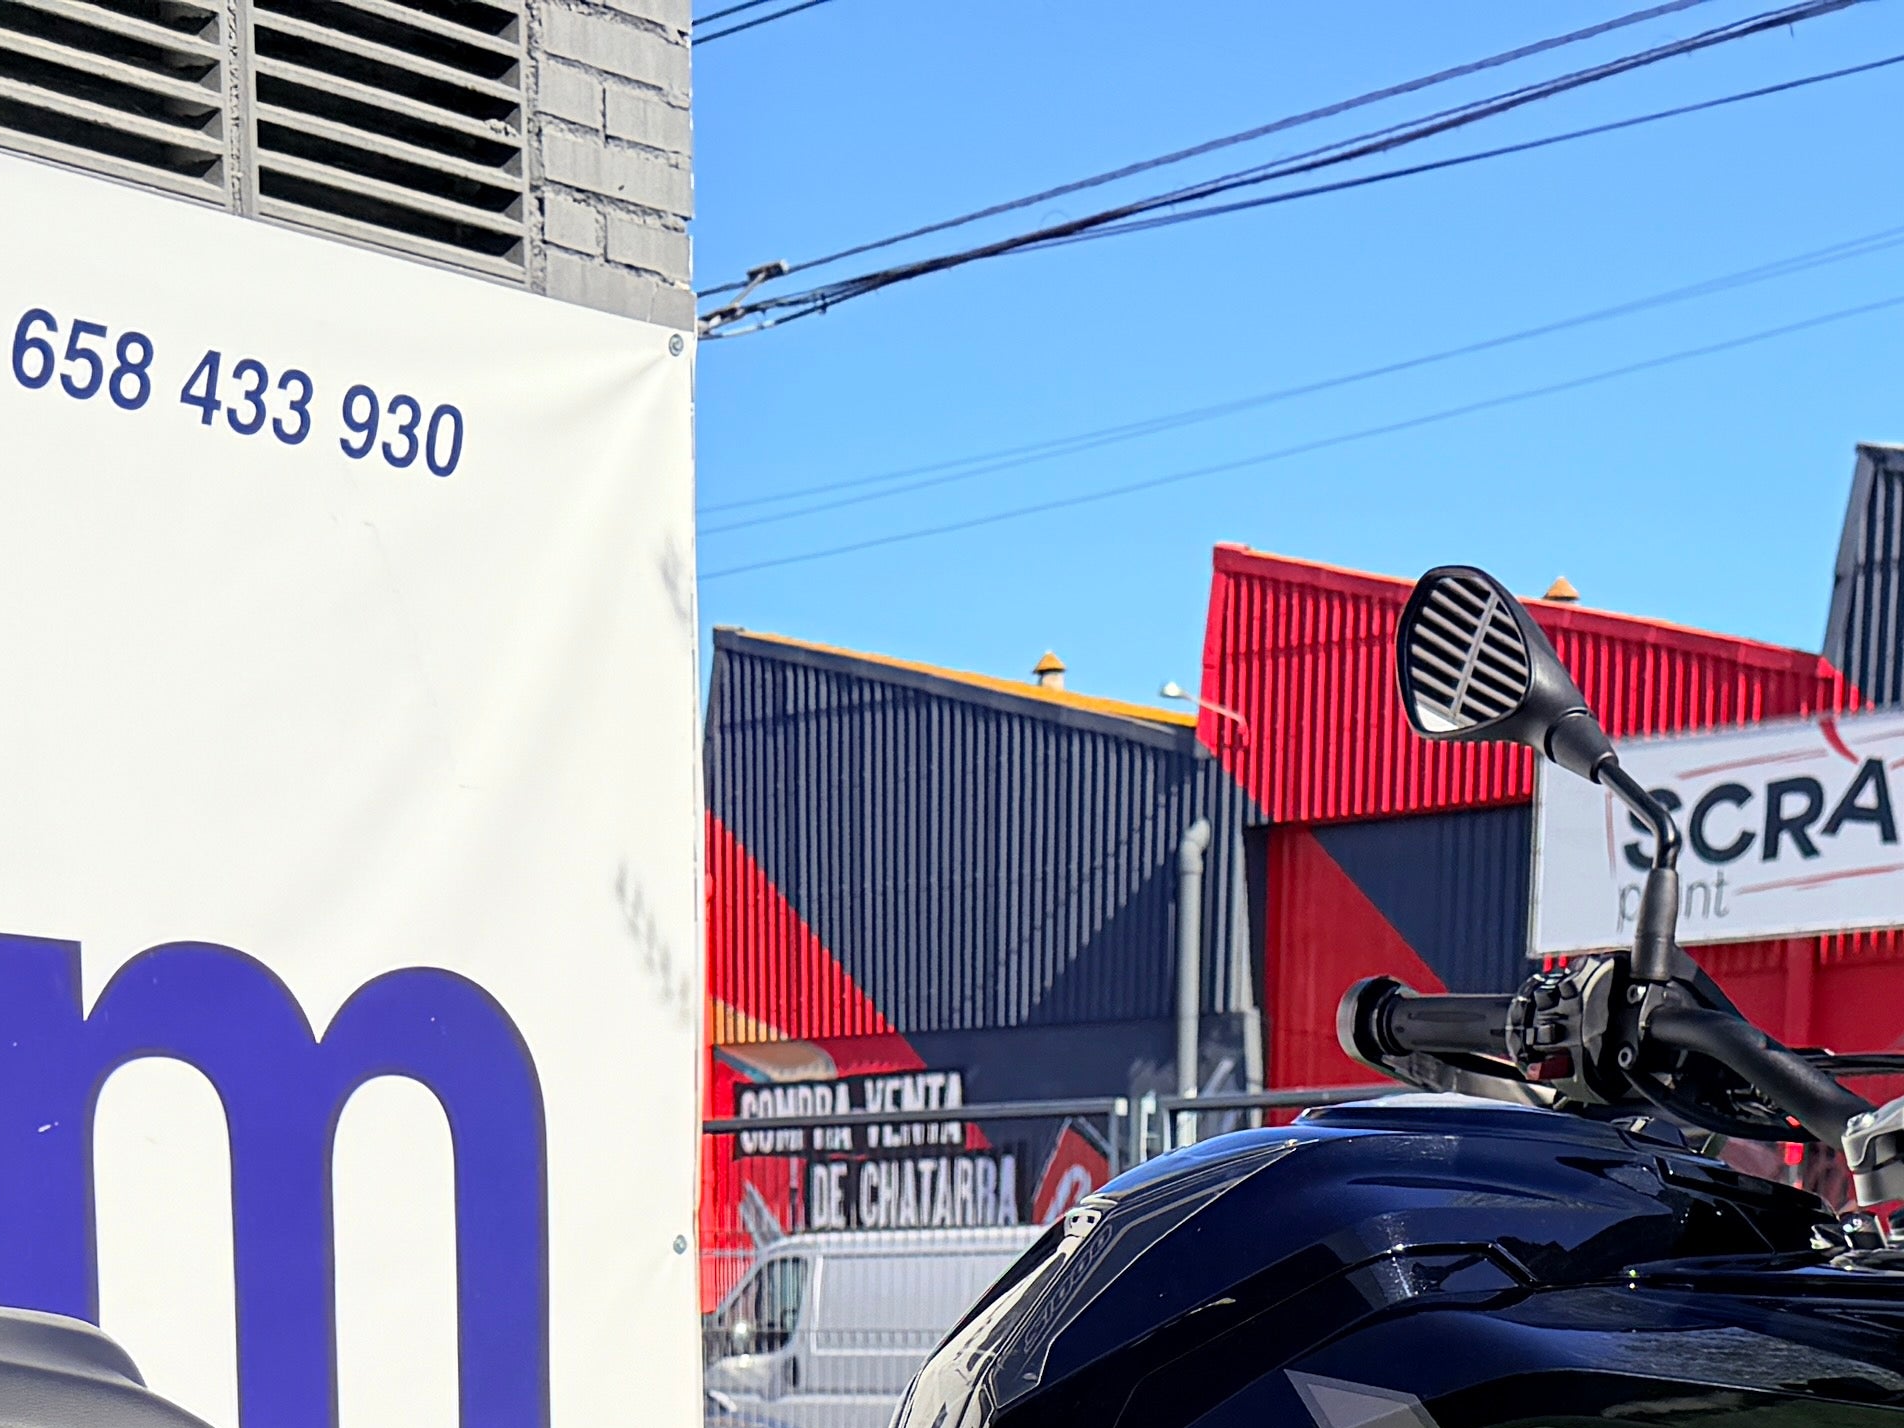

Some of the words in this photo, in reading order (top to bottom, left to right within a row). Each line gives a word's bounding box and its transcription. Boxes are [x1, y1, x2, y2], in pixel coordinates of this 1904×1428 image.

[11, 307, 154, 411] 658
[179, 349, 314, 446] 433
[338, 383, 464, 478] 930
[1615, 868, 1731, 934] pnt
[809, 1159, 848, 1231] DE
[858, 1153, 1019, 1228] CHATARRA
